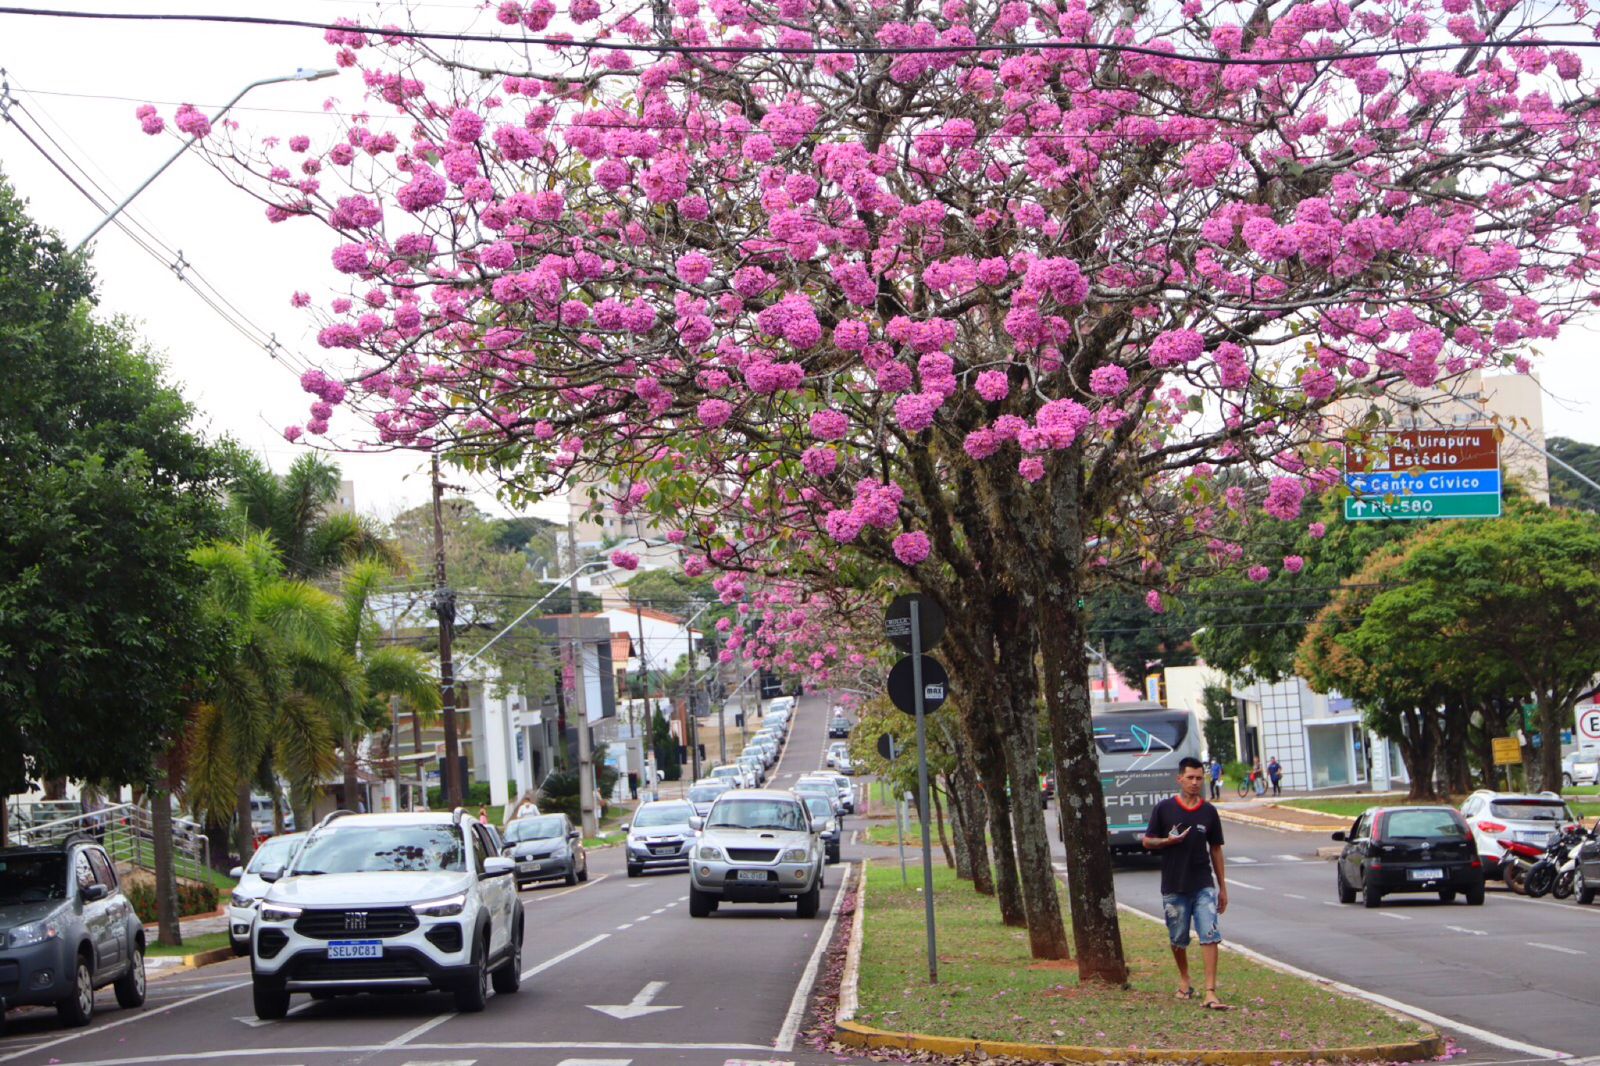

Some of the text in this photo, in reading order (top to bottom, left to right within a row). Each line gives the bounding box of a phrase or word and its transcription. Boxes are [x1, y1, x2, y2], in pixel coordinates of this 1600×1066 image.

[1418, 435, 1480, 450] Uirapuru
[1394, 453, 1458, 466] Estádio
[1371, 475, 1480, 491] Centro Cívico
[1589, 716, 1600, 732] E
[344, 911, 369, 929] FIAT
[332, 945, 377, 957] SEL9C81
